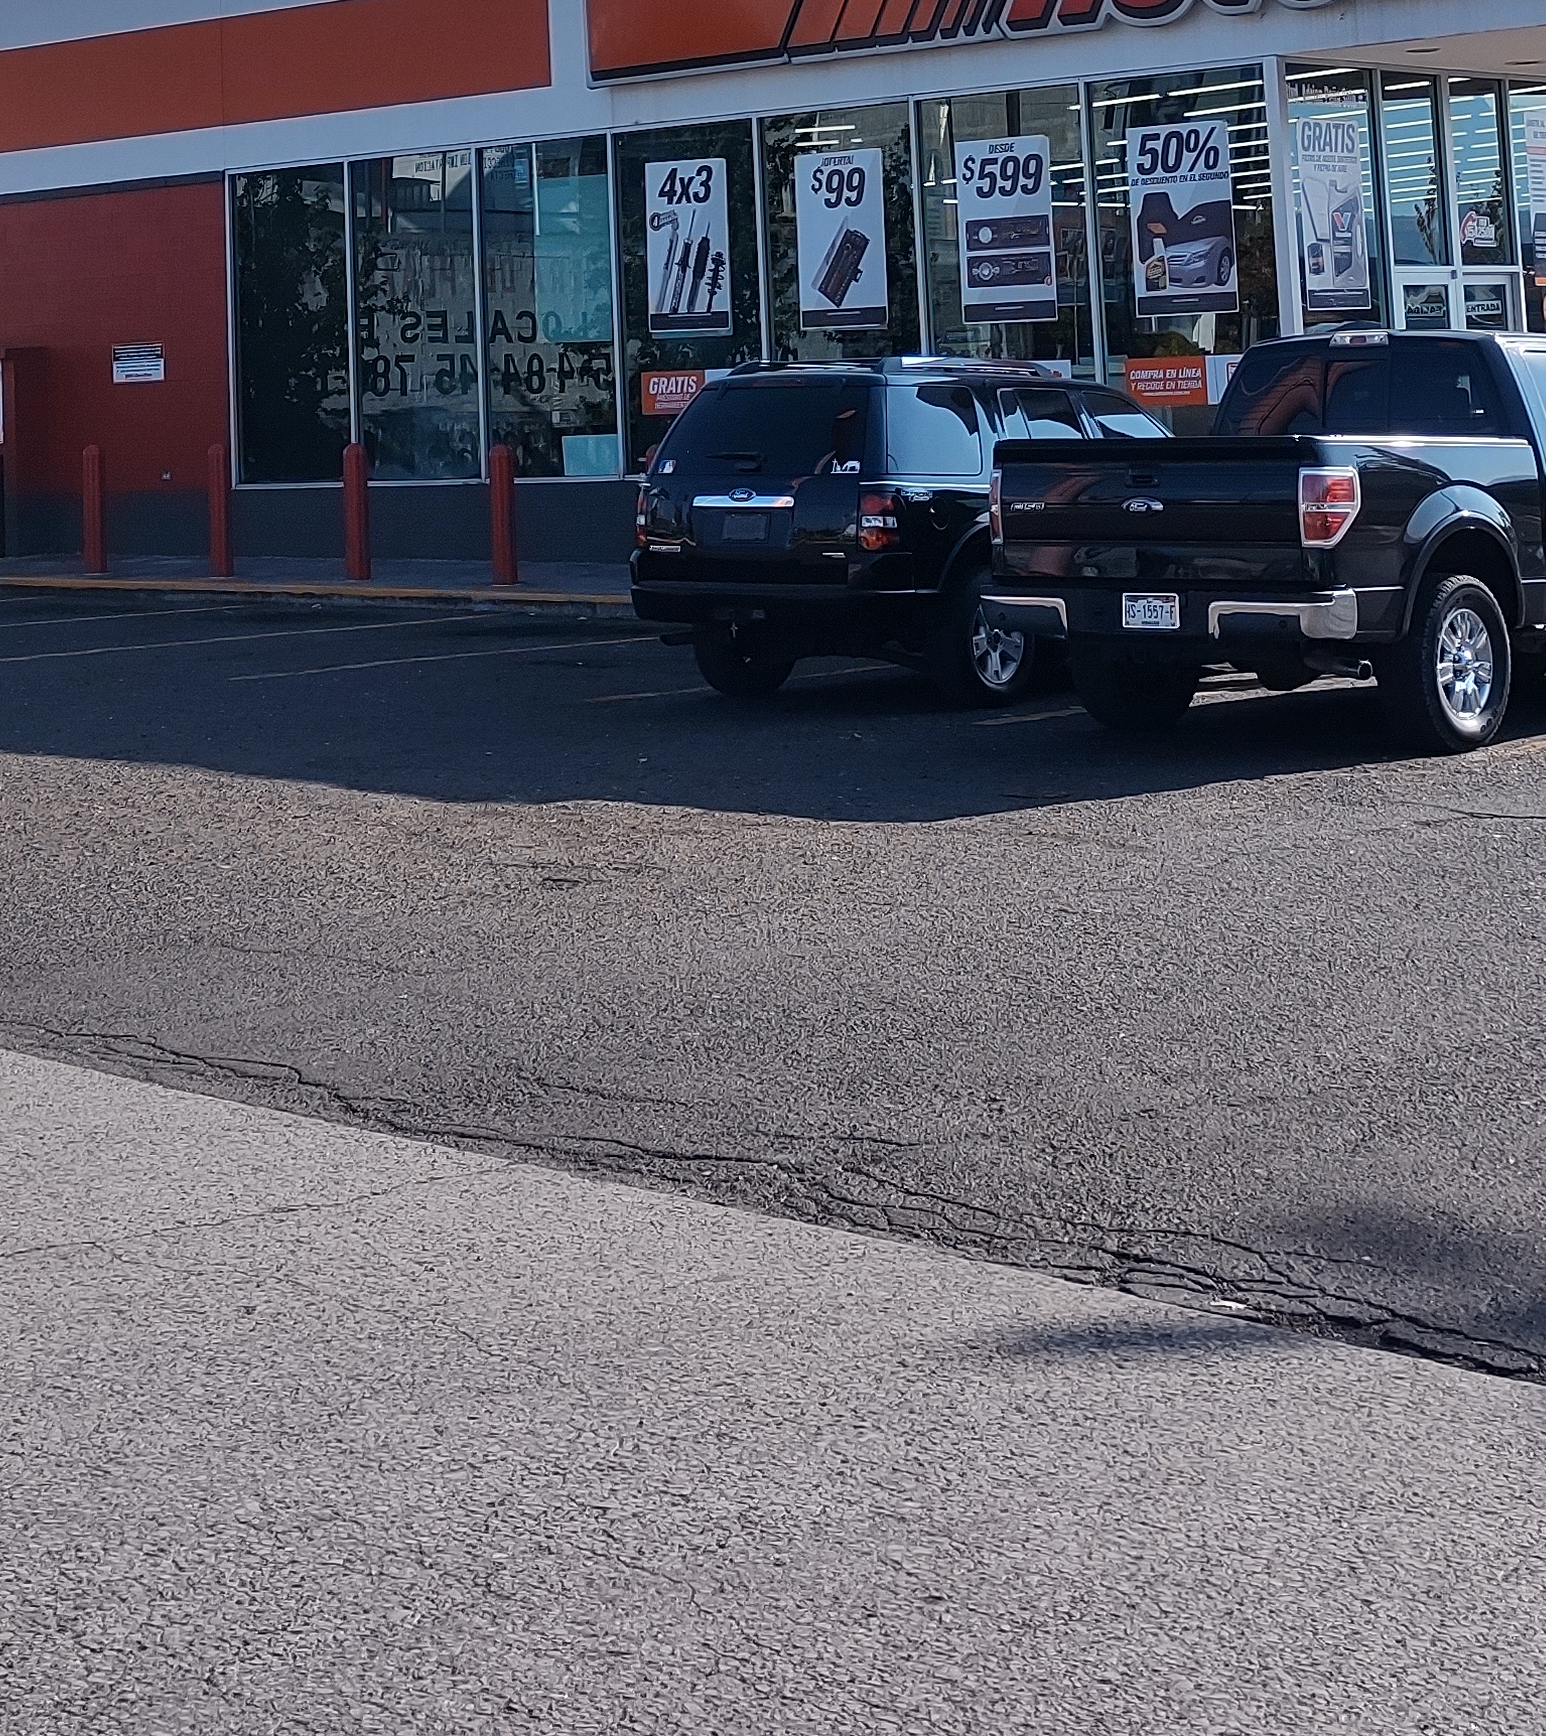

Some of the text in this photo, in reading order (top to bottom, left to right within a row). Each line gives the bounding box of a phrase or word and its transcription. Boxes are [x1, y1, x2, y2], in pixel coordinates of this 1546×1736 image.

[1301, 121, 1355, 153] GRATIS
[988, 142, 1015, 154] DESDE
[1136, 126, 1220, 176] 50%
[657, 164, 714, 206] 4x3
[961, 153, 1043, 199] $599
[1131, 178, 1139, 186] DE
[1140, 175, 1178, 185] DESCUENTO
[810, 166, 866, 209] $99
[1466, 302, 1500, 314] ENTRADA
[1129, 369, 1164, 380] COMPRA
[1166, 368, 1178, 379] EN
[649, 375, 698, 395] GRATIS
[1137, 381, 1164, 391] RECOGE
[1166, 380, 1176, 390] EN
[1177, 379, 1203, 390] TIENDA
